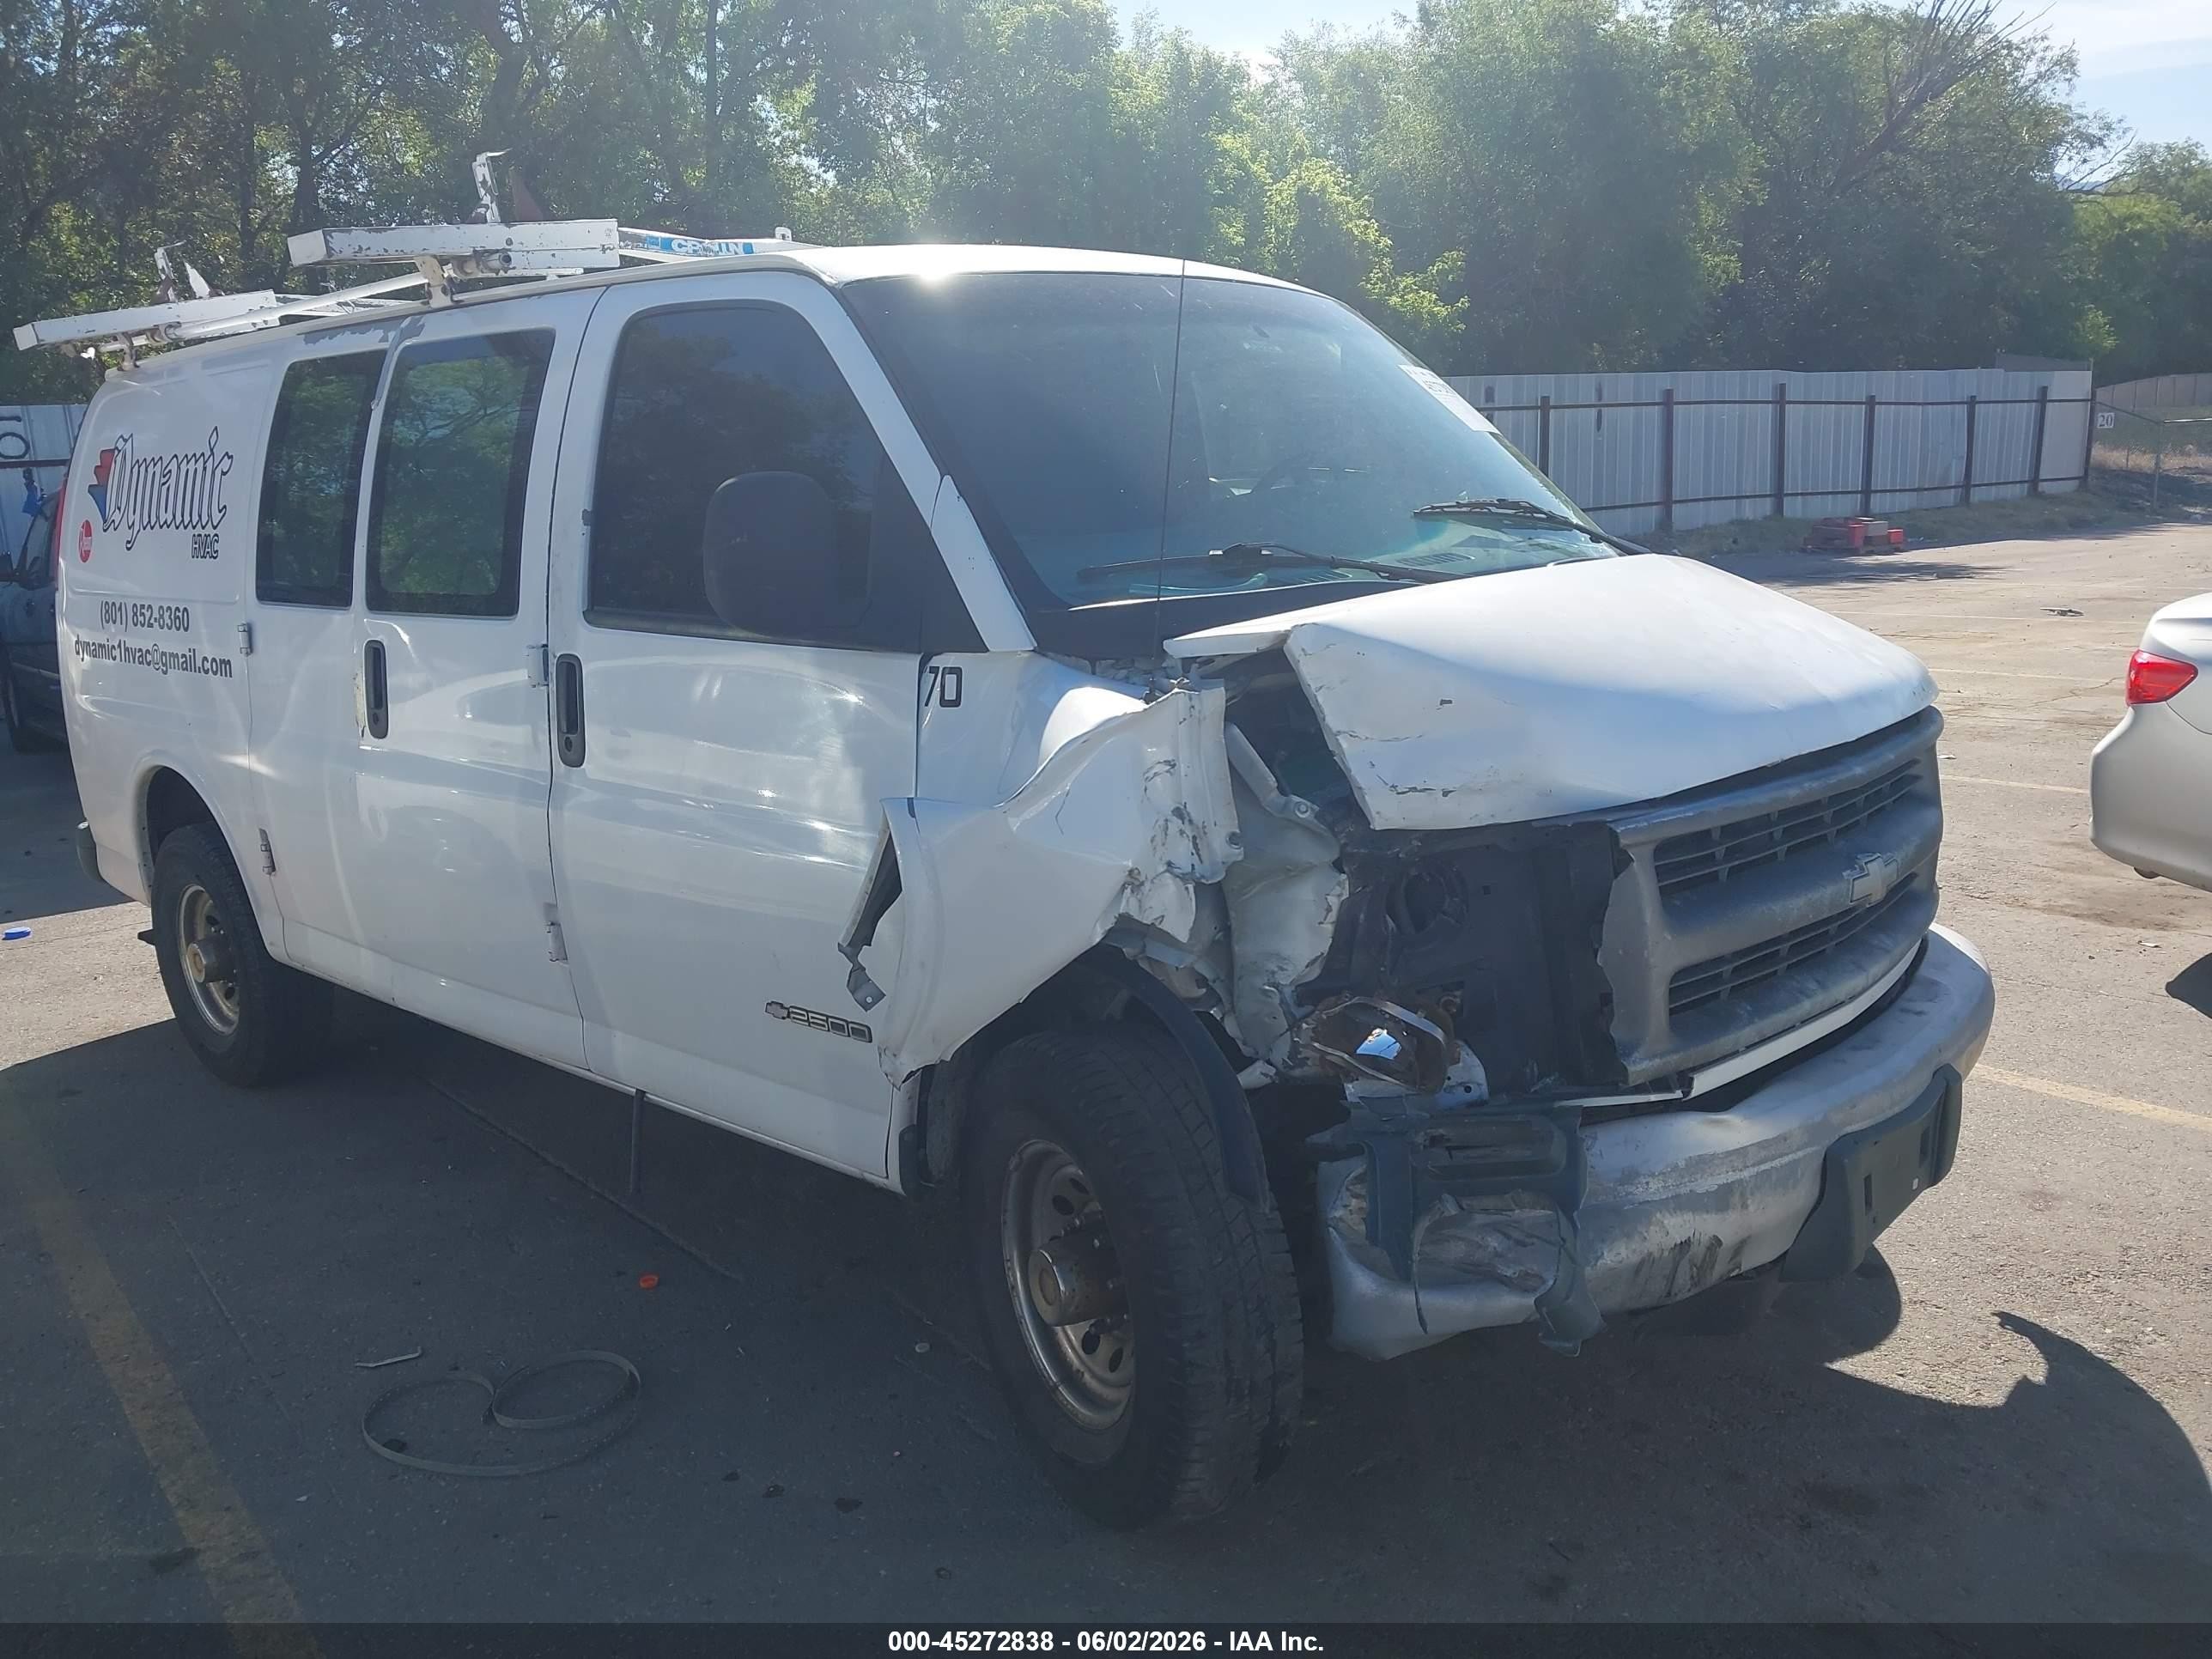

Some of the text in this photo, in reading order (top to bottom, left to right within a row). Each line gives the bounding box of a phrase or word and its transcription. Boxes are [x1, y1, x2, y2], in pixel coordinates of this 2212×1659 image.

[2099, 414, 2114, 428] 20
[102, 426, 234, 550] Dynamic
[191, 533, 220, 559] HVAC
[100, 600, 190, 633] (801) 852-8360
[75, 634, 234, 678] dynamic1hvac@gmail.com
[924, 665, 963, 708] 70
[788, 1005, 873, 1044] 2500
